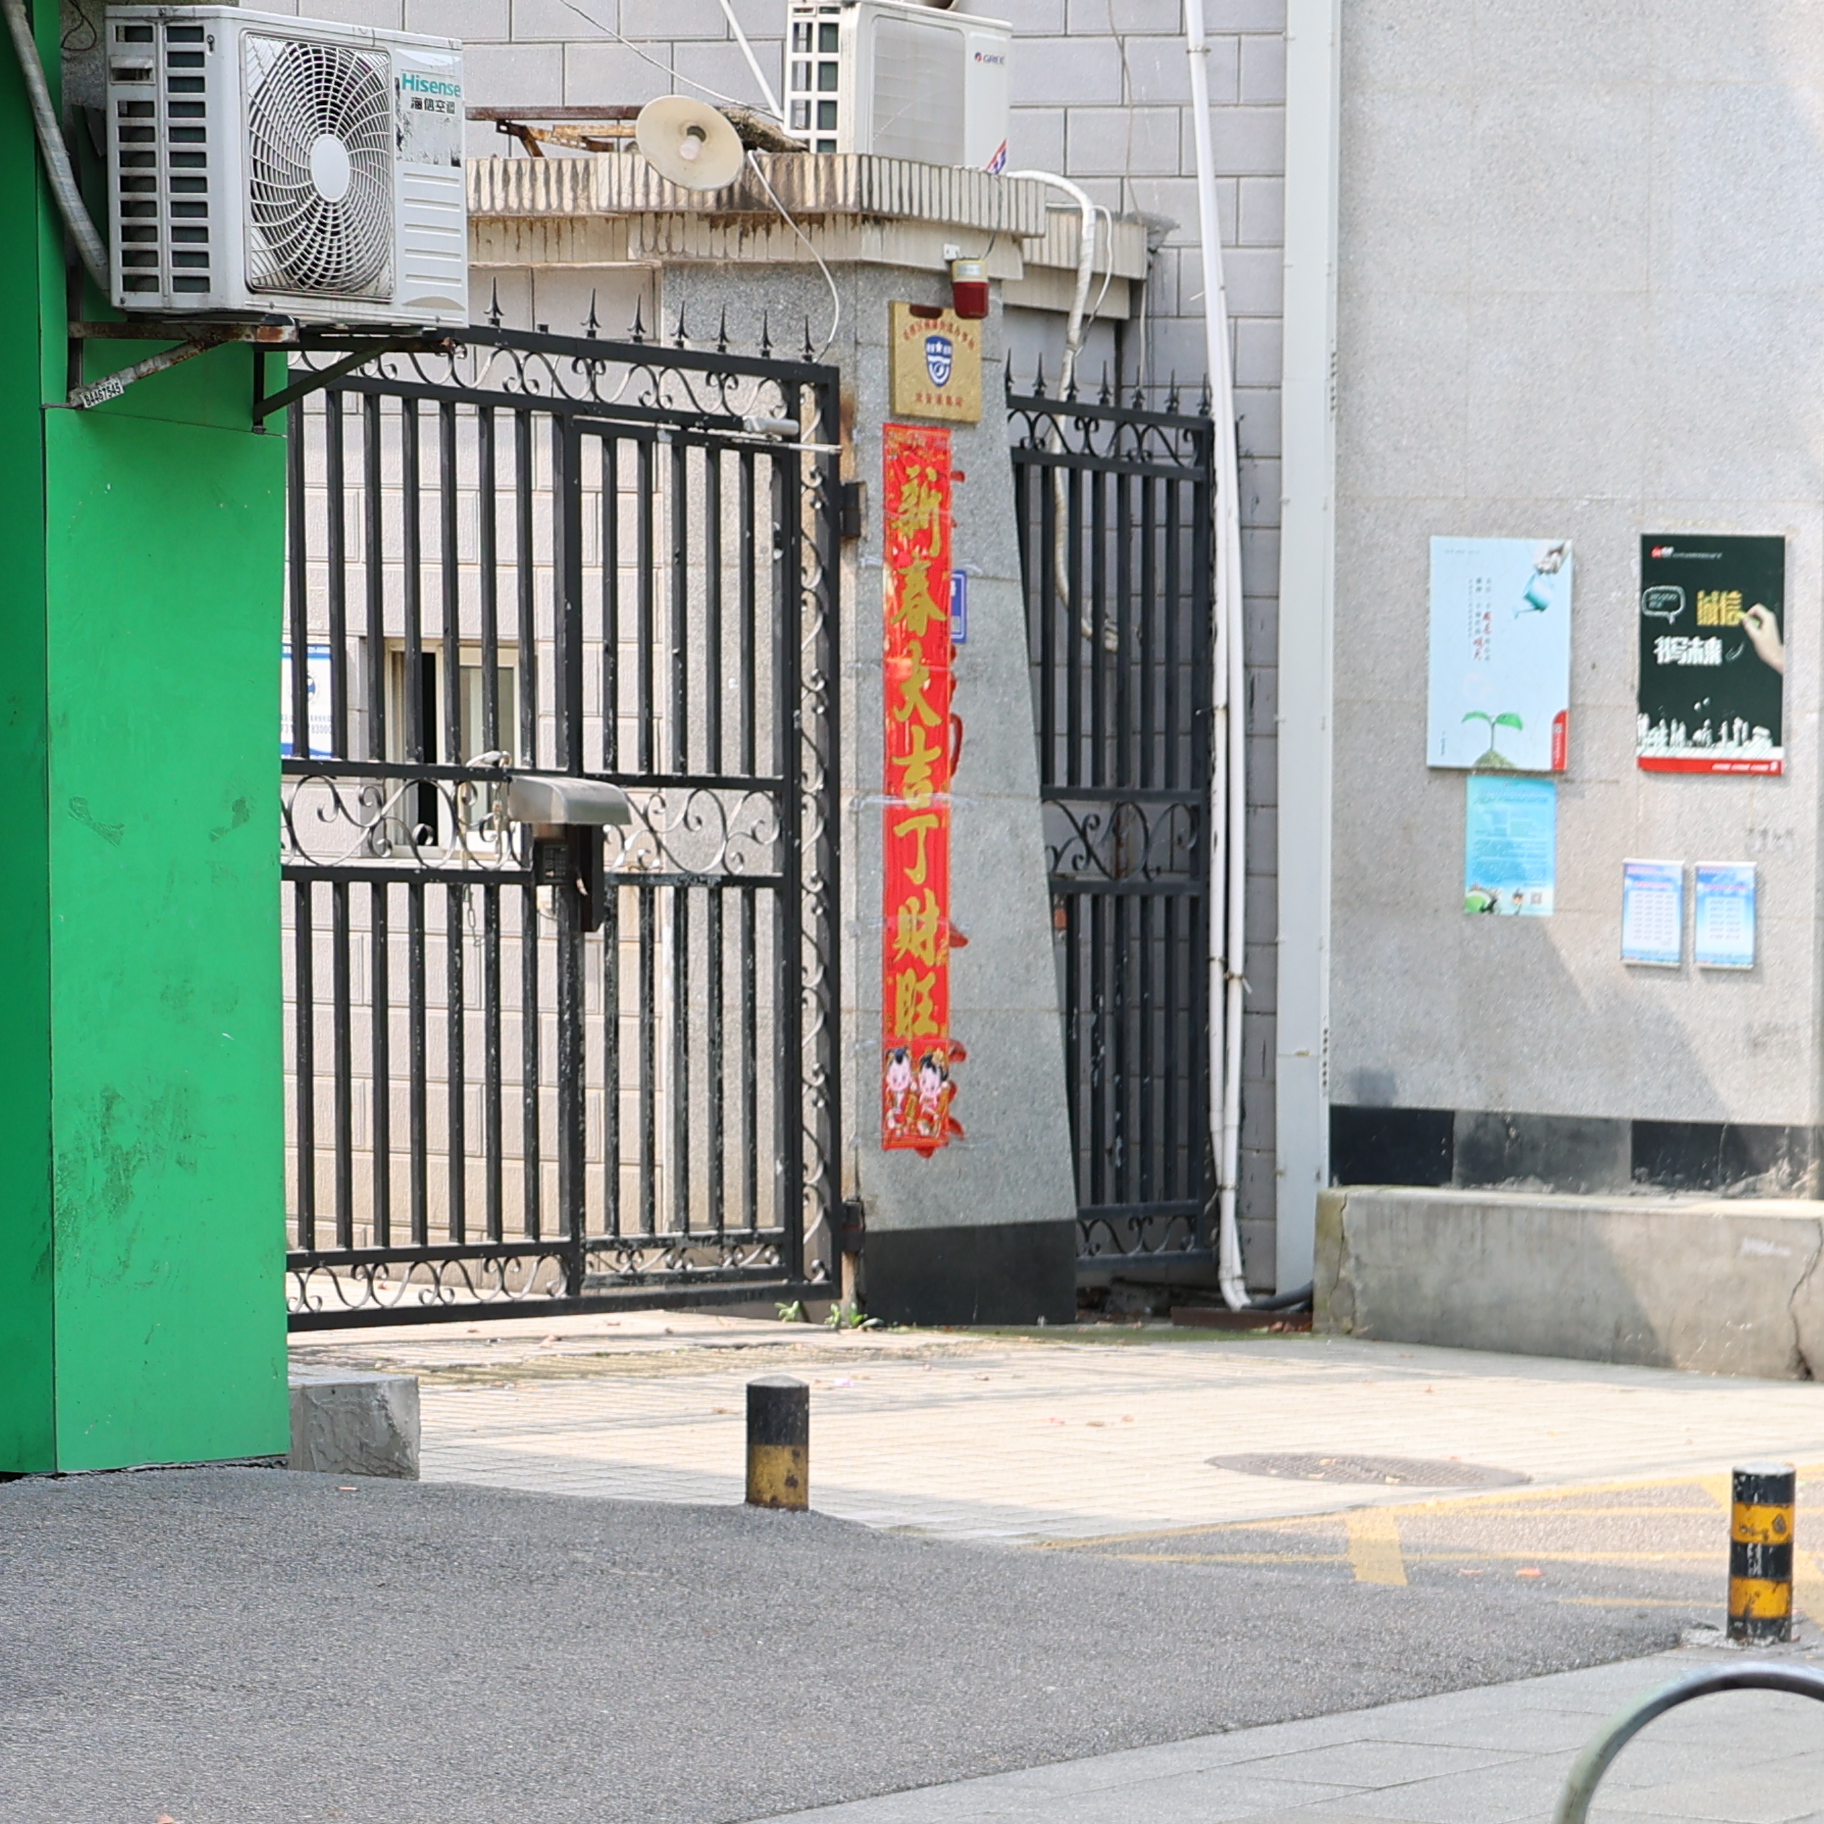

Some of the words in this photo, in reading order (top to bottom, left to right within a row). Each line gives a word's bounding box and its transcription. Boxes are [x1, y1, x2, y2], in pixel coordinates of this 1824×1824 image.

[401, 73, 462, 98] Hisense
[890, 464, 947, 1042] 新春大吉丁财旺
